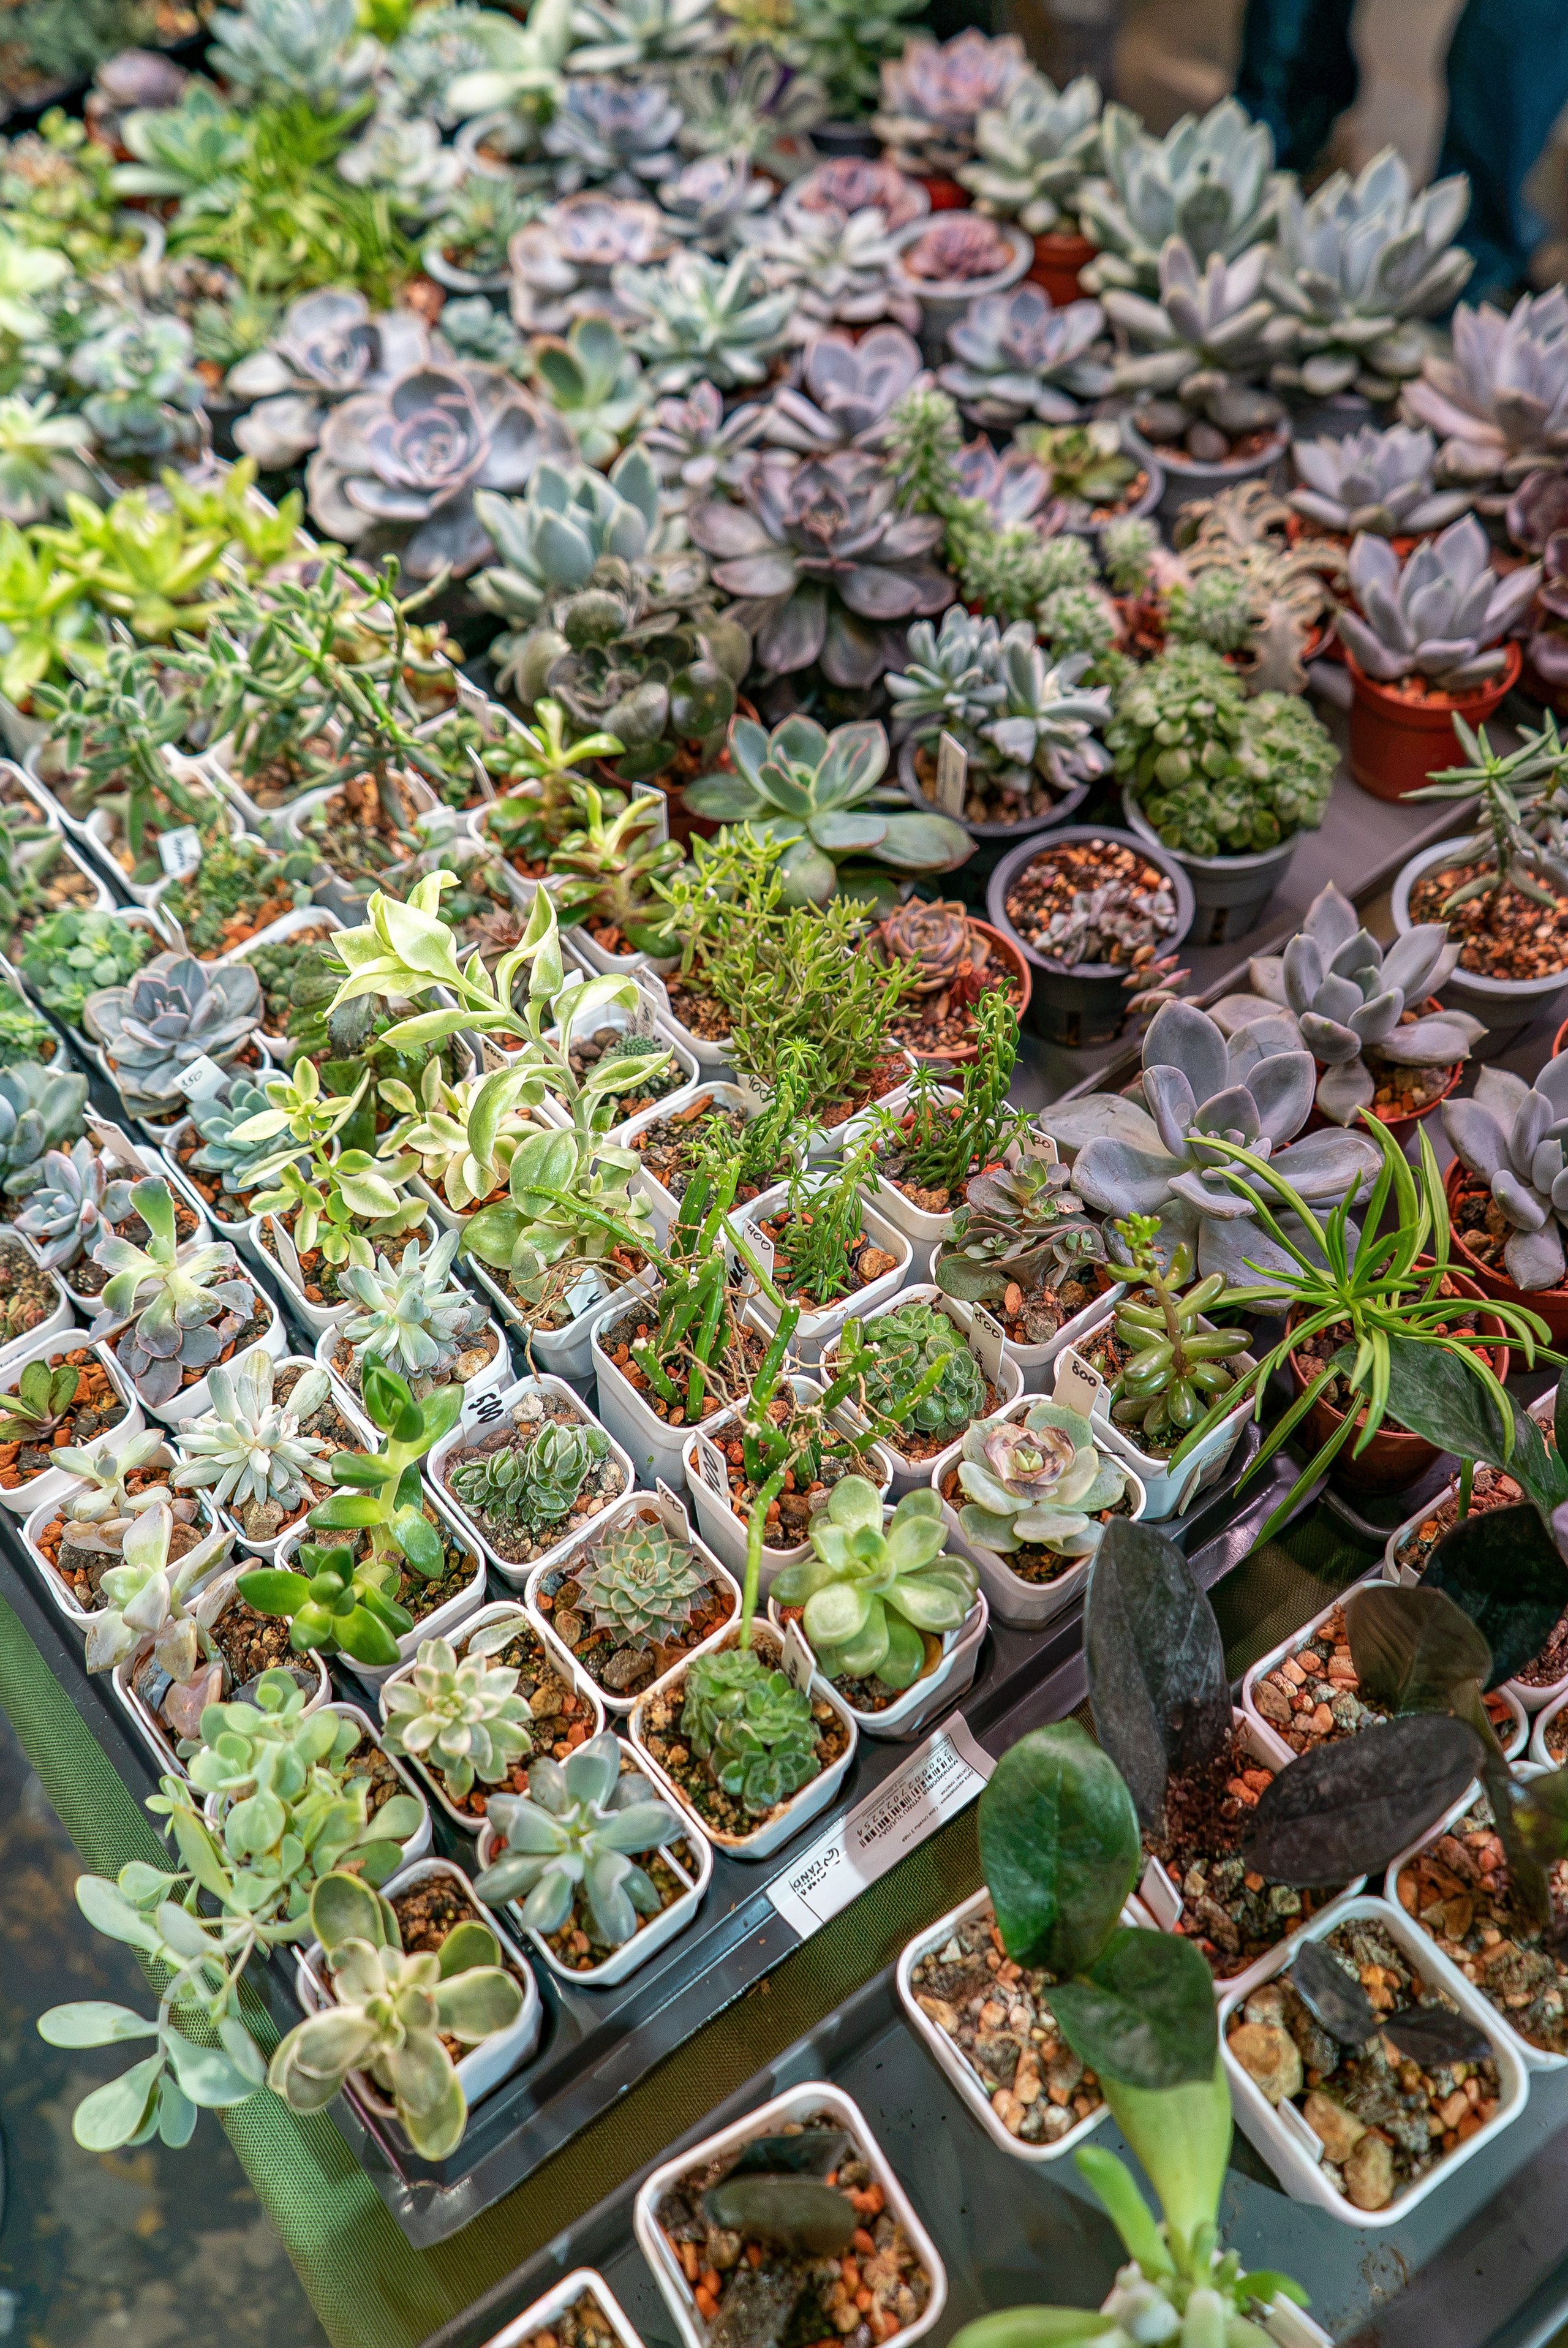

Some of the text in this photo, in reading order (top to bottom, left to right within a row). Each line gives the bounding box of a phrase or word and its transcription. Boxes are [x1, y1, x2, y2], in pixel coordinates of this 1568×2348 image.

[747, 1225, 771, 1251] 400
[974, 1312, 1000, 1338] 800
[1072, 1360, 1097, 1387] 800
[468, 1393, 503, 1424] 500
[794, 1860, 821, 1888] LAND
